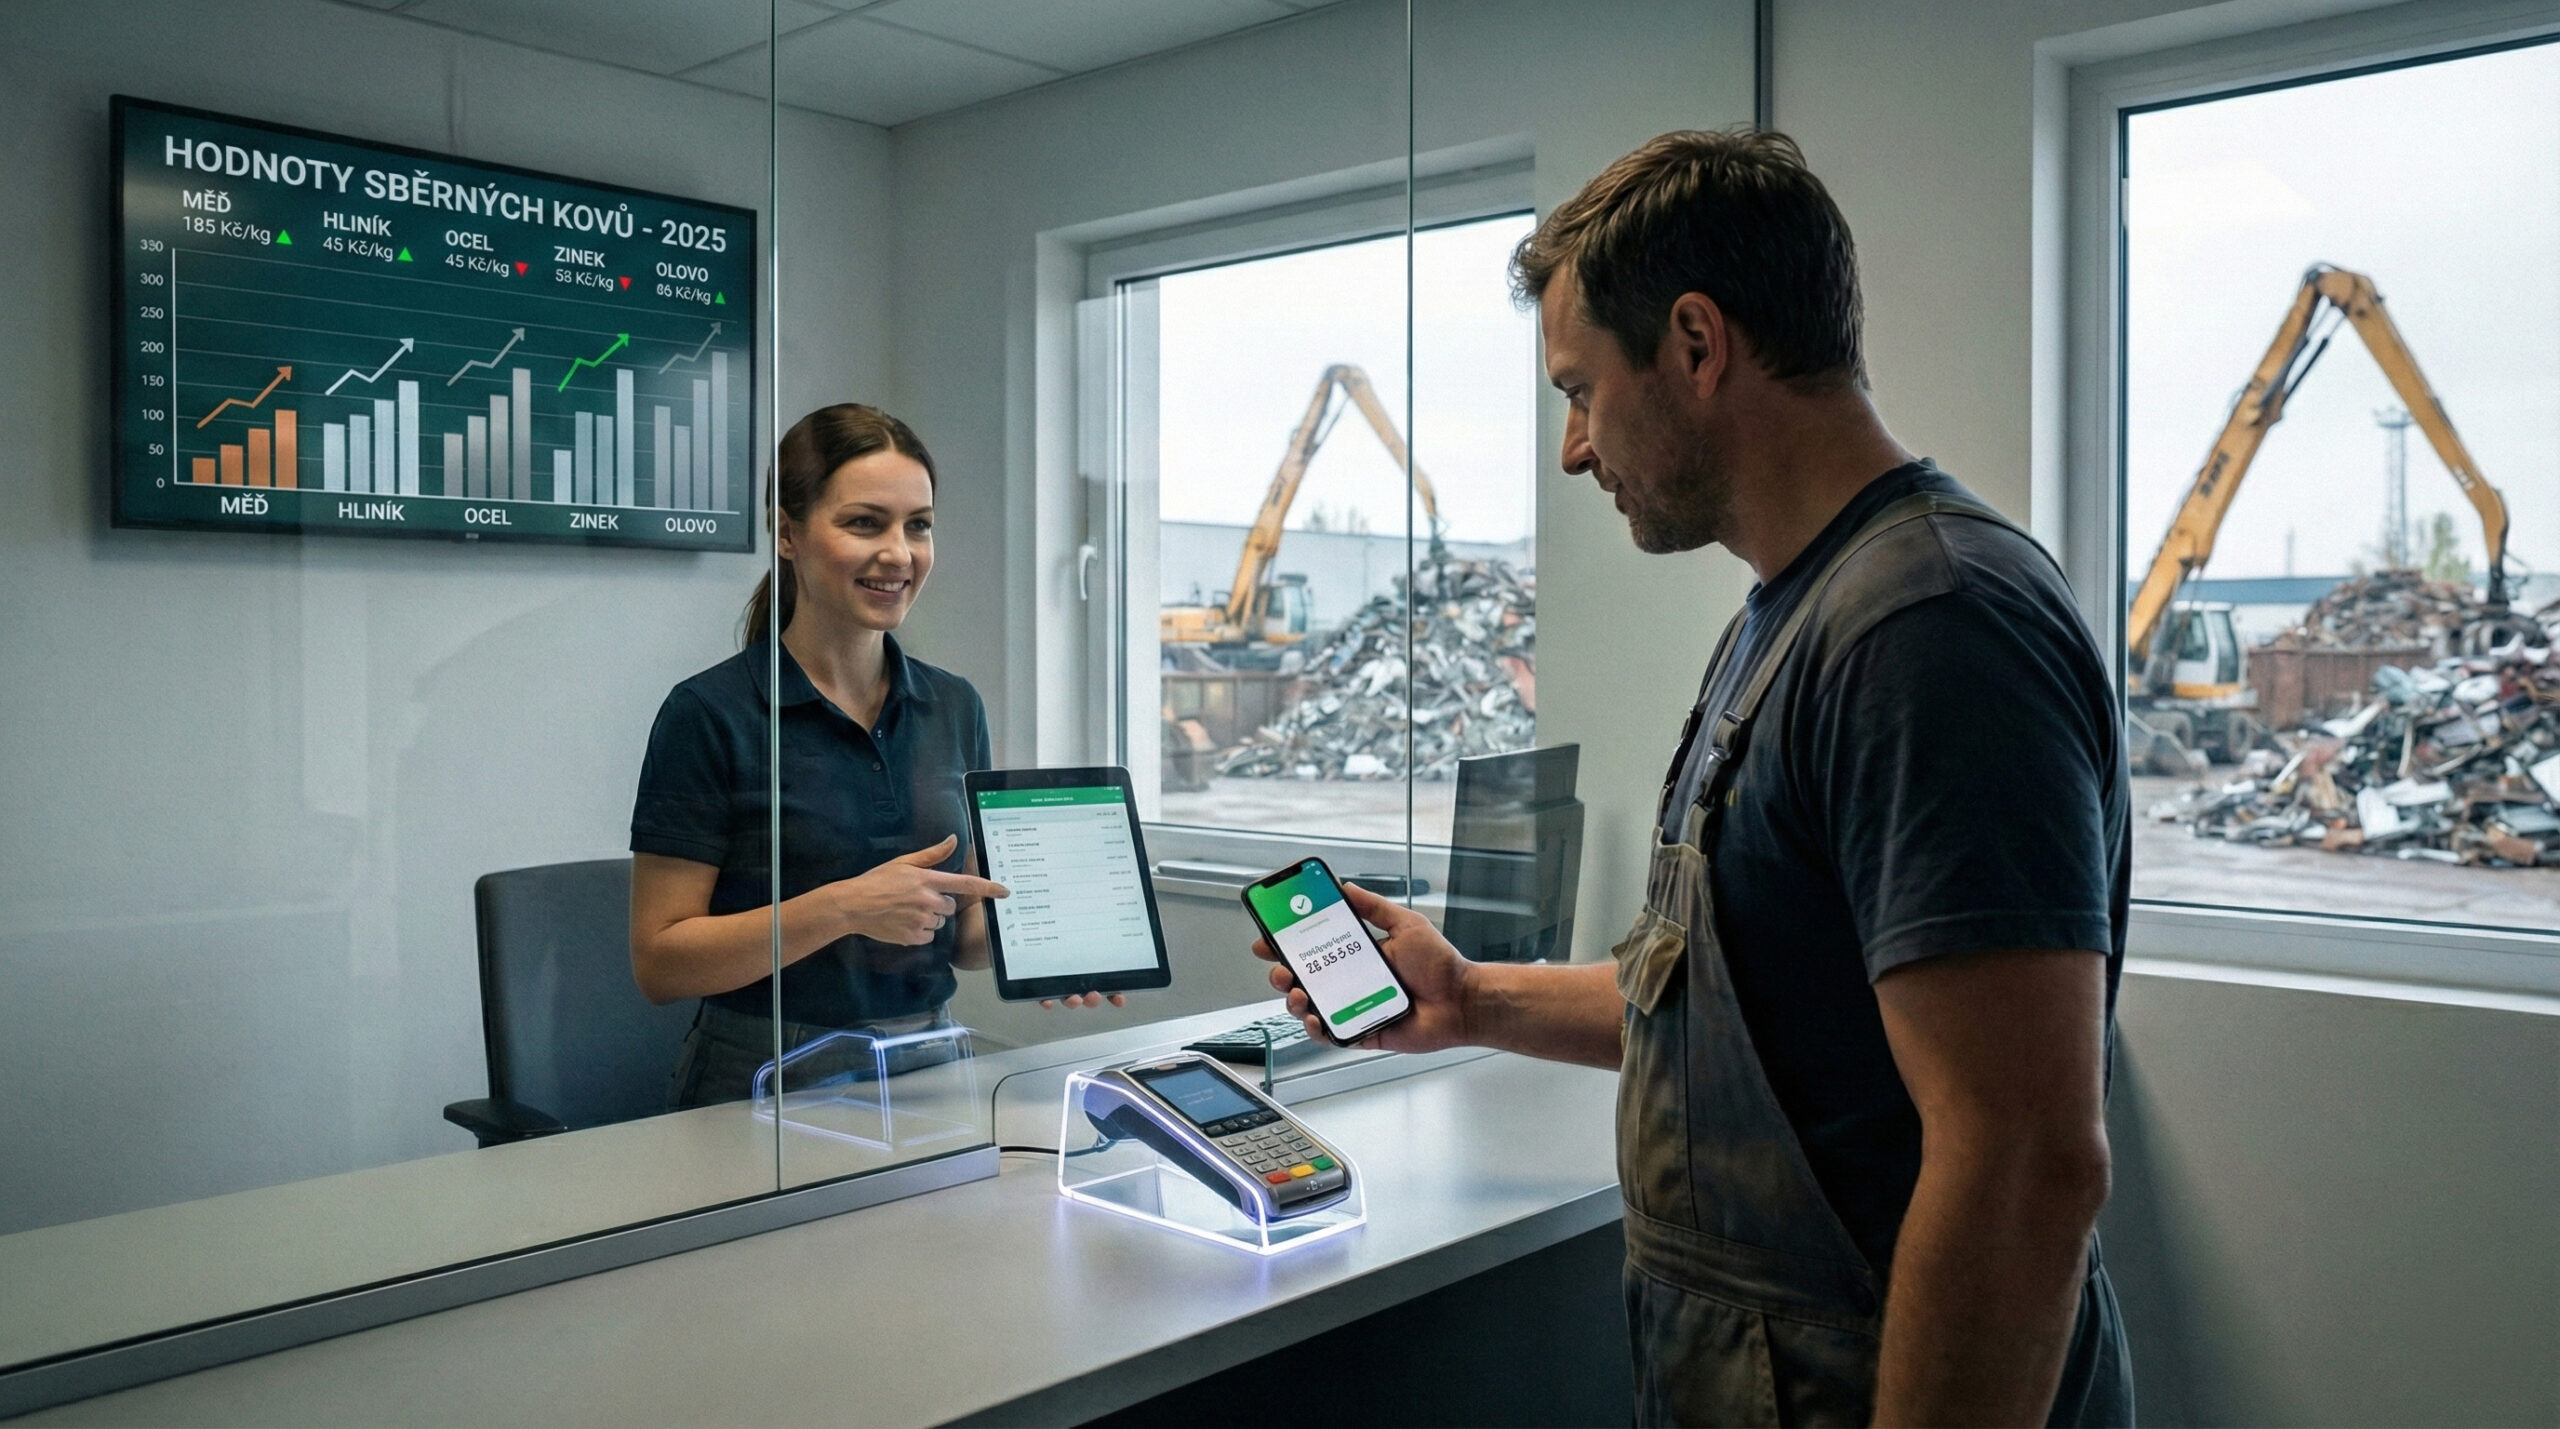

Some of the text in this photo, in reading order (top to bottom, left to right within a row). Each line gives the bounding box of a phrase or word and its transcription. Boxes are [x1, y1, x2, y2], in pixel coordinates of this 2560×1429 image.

[165, 135, 355, 193] HODNOTY
[364, 169, 544, 224] SBĚRNÝCH
[553, 201, 634, 238] KOVŮ
[661, 219, 727, 252] 2025
[182, 189, 232, 213] MĚĎ
[182, 216, 271, 245] 185 Kč/kg
[323, 211, 392, 237] HLINÍK
[323, 237, 393, 262] 45 Kč/kg
[445, 230, 494, 251] OCEL
[445, 254, 509, 277] 45 Kč/kg
[553, 245, 605, 268] ZINEK
[140, 273, 164, 286] 300
[576, 271, 614, 292] Kč/kg
[656, 262, 709, 282] OLOVO
[675, 286, 711, 305] Kč/kg
[140, 306, 164, 319] 250
[140, 341, 165, 353] 200
[141, 375, 165, 387] 150
[141, 409, 165, 421] 100
[148, 443, 164, 455] 50
[156, 477, 165, 488] 0
[220, 493, 269, 515] MĚĎ
[338, 500, 405, 521] HLINÍK
[464, 507, 512, 525] OCEL
[569, 512, 619, 530] ZINEK
[665, 517, 717, 534] OLOVO
